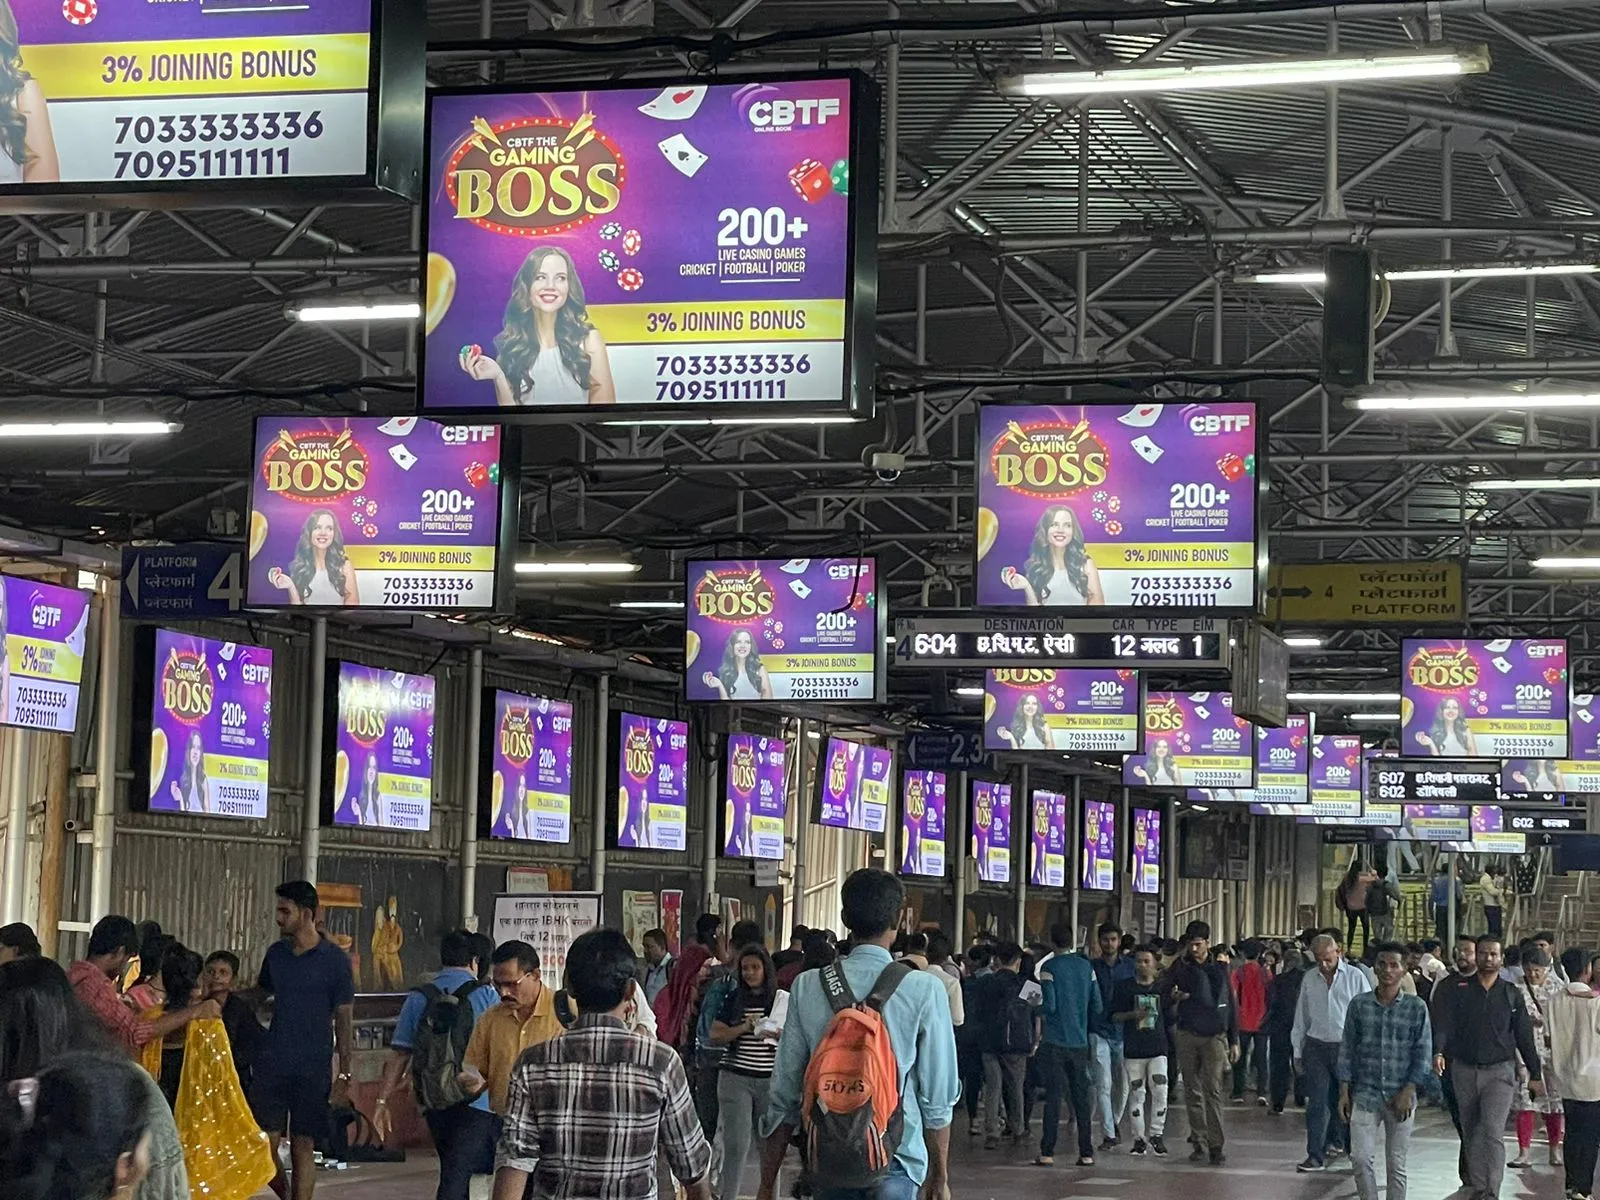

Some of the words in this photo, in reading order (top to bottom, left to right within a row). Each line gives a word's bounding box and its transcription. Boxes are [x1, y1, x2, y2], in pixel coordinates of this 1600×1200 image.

[102, 55, 143, 83] 3%
[148, 52, 233, 82] JOINING
[241, 49, 317, 79] BONUS
[749, 98, 840, 126] CBTF
[114, 110, 324, 145] 7033333336
[506, 137, 534, 148] CBTF
[536, 136, 558, 146] THE
[113, 147, 290, 179] 7095111111
[489, 145, 576, 167] GAMING
[453, 163, 620, 219] BOSS
[718, 206, 809, 247] 200+
[718, 249, 737, 261] LIVE
[739, 248, 772, 261] CASINO
[774, 247, 806, 260] GAMES
[680, 263, 717, 276] CRICKET
[724, 262, 768, 275] FOOTBALL
[776, 261, 806, 273] POKER
[647, 312, 677, 334] 3%
[680, 311, 744, 334] JOINING
[750, 310, 806, 331] BONUS
[656, 354, 811, 377] 7033333336
[655, 379, 787, 402] 7095111111
[1190, 415, 1250, 432] CBTF
[442, 426, 495, 442] CBTF
[288, 449, 340, 461] GAMING
[1019, 441, 1077, 454] GAMING
[266, 460, 367, 492] BOSS
[995, 452, 1106, 487] BOSS
[421, 490, 474, 514] 200+
[1170, 483, 1230, 508] 200+
[144, 556, 198, 568] PLATFORM
[378, 551, 397, 564] 3%
[399, 551, 436, 564] JOINING
[438, 551, 472, 564] BONUS
[1124, 550, 1144, 562] 3%
[1147, 550, 1188, 562] JOINING
[1192, 549, 1229, 562] BONUS
[208, 552, 244, 611] 4
[383, 577, 474, 591] 7033333336
[714, 584, 753, 593] GAMING
[1131, 576, 1232, 590] 7033333336
[1324, 584, 1334, 598] 4
[383, 592, 459, 606] 7095111111
[698, 592, 774, 616] BOSS
[1131, 593, 1216, 606] 7095111111
[32, 604, 61, 628] CBTF
[1352, 604, 1456, 615] PLATFORM
[816, 612, 857, 630] 200+
[984, 618, 1064, 631] DESTINATION
[1113, 619, 1135, 631] CAR
[1146, 618, 1178, 631] TYPE
[896, 635, 912, 661] 4
[1112, 634, 1136, 656] 12
[1192, 634, 1202, 656] 1
[786, 658, 800, 668] 3%
[832, 658, 856, 668] BONUS
[1412, 666, 1479, 686] BOSS
[164, 678, 212, 716] BOSS
[1091, 681, 1124, 696] 200+
[1516, 684, 1552, 700] 200+
[222, 702, 247, 727] 200+
[392, 726, 414, 749] 200+
[501, 730, 534, 759] BOSS
[1212, 728, 1241, 742] 200+
[626, 748, 654, 774] BOSS
[538, 931, 550, 942] 12
